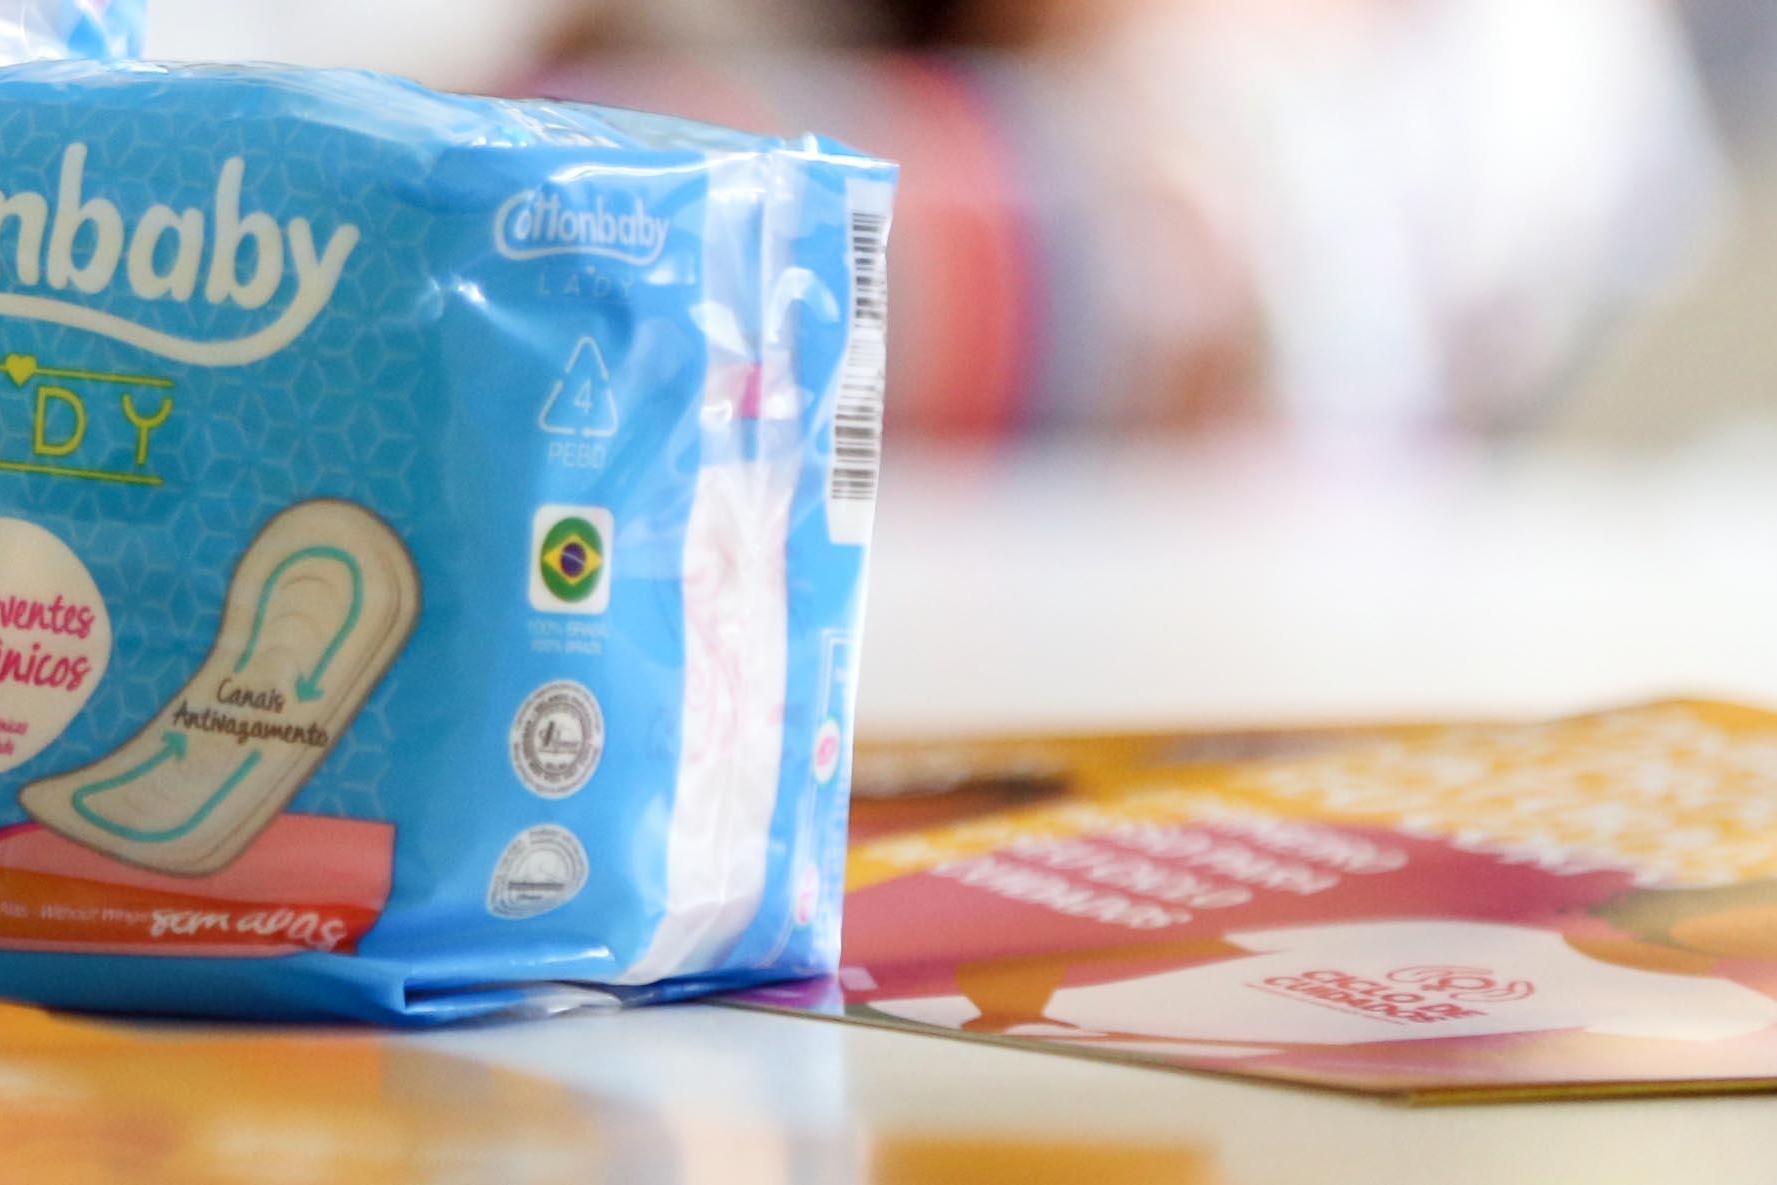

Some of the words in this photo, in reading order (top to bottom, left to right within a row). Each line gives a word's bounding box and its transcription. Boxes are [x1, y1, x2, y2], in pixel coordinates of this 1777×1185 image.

[493, 187, 671, 267] Cottonbaby
[572, 379, 593, 414] 4
[548, 440, 607, 470] PEBD
[216, 679, 286, 714] Canais
[172, 700, 330, 747] Antivazamento
[148, 908, 229, 938] sem
